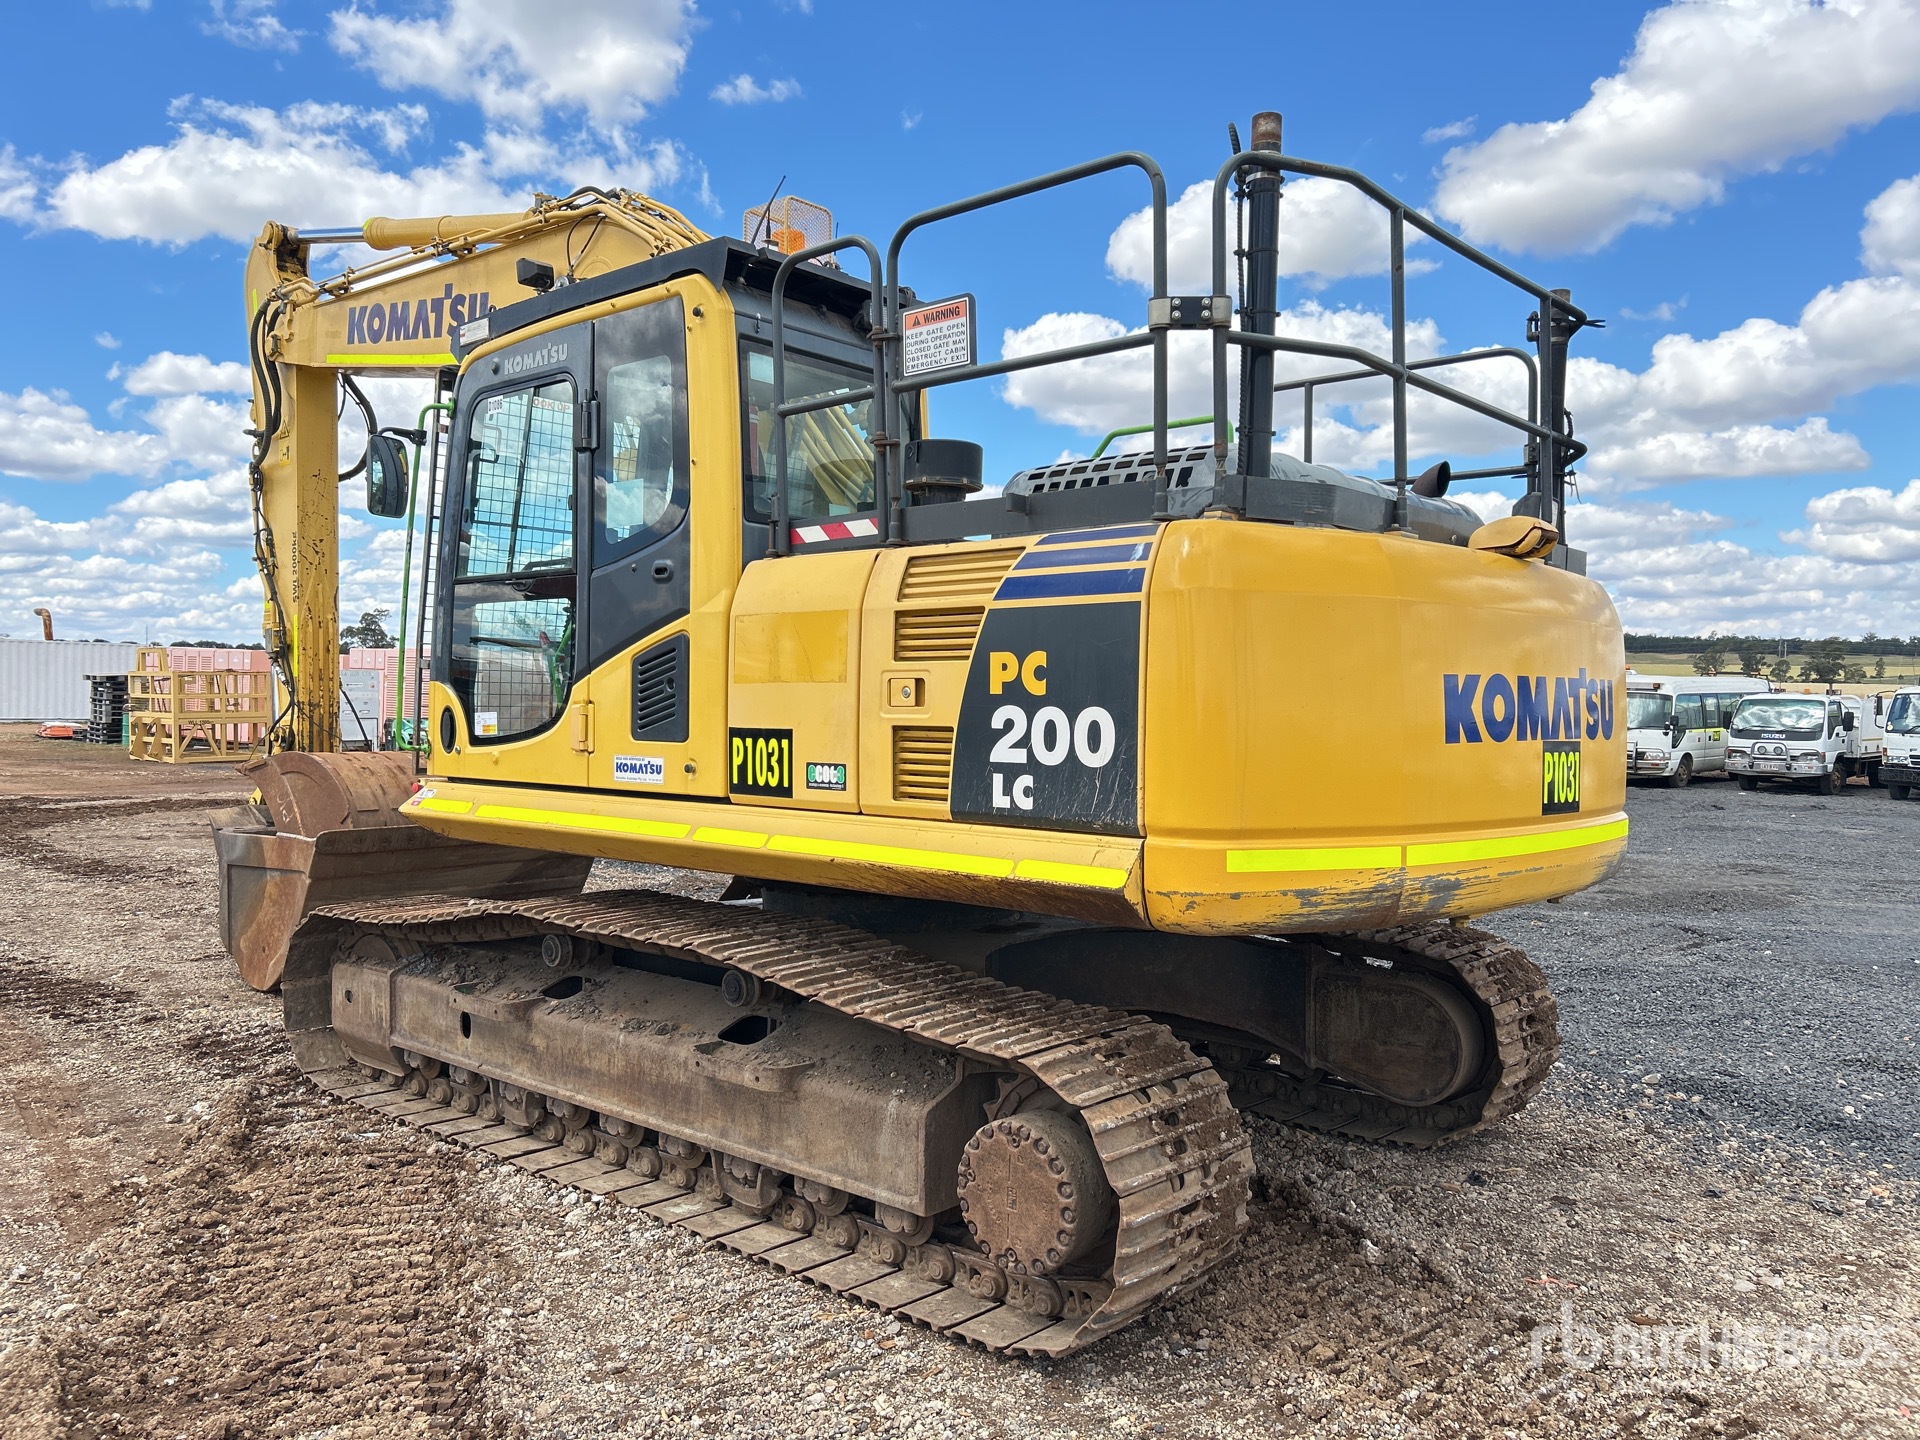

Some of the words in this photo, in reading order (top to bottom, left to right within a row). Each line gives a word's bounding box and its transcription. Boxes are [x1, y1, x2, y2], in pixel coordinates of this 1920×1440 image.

[923, 306, 960, 324] WARNING
[906, 331, 923, 340] KEEP
[926, 327, 944, 336] GATE
[946, 322, 965, 332] OPEN
[906, 339, 929, 348] DURING
[930, 330, 966, 343] OPERATION
[906, 345, 932, 356] CLOSED
[933, 341, 951, 349] GATE
[952, 337, 966, 346] MAY
[906, 350, 942, 364] OBSTRUCT
[944, 346, 966, 356] CABIN
[504, 342, 568, 375] KOMATSU
[906, 357, 948, 371] EMERGENCY
[950, 353, 966, 362] EXIT
[533, 397, 555, 410] OOK
[989, 650, 1047, 696] PC
[1443, 667, 1614, 744] KOMATSU
[989, 704, 1116, 768] 200
[615, 760, 662, 775] KOMATSU
[732, 737, 789, 787] P1031
[808, 764, 845, 784] ecot3
[1543, 751, 1580, 804] P1031
[992, 773, 1034, 810] LC
